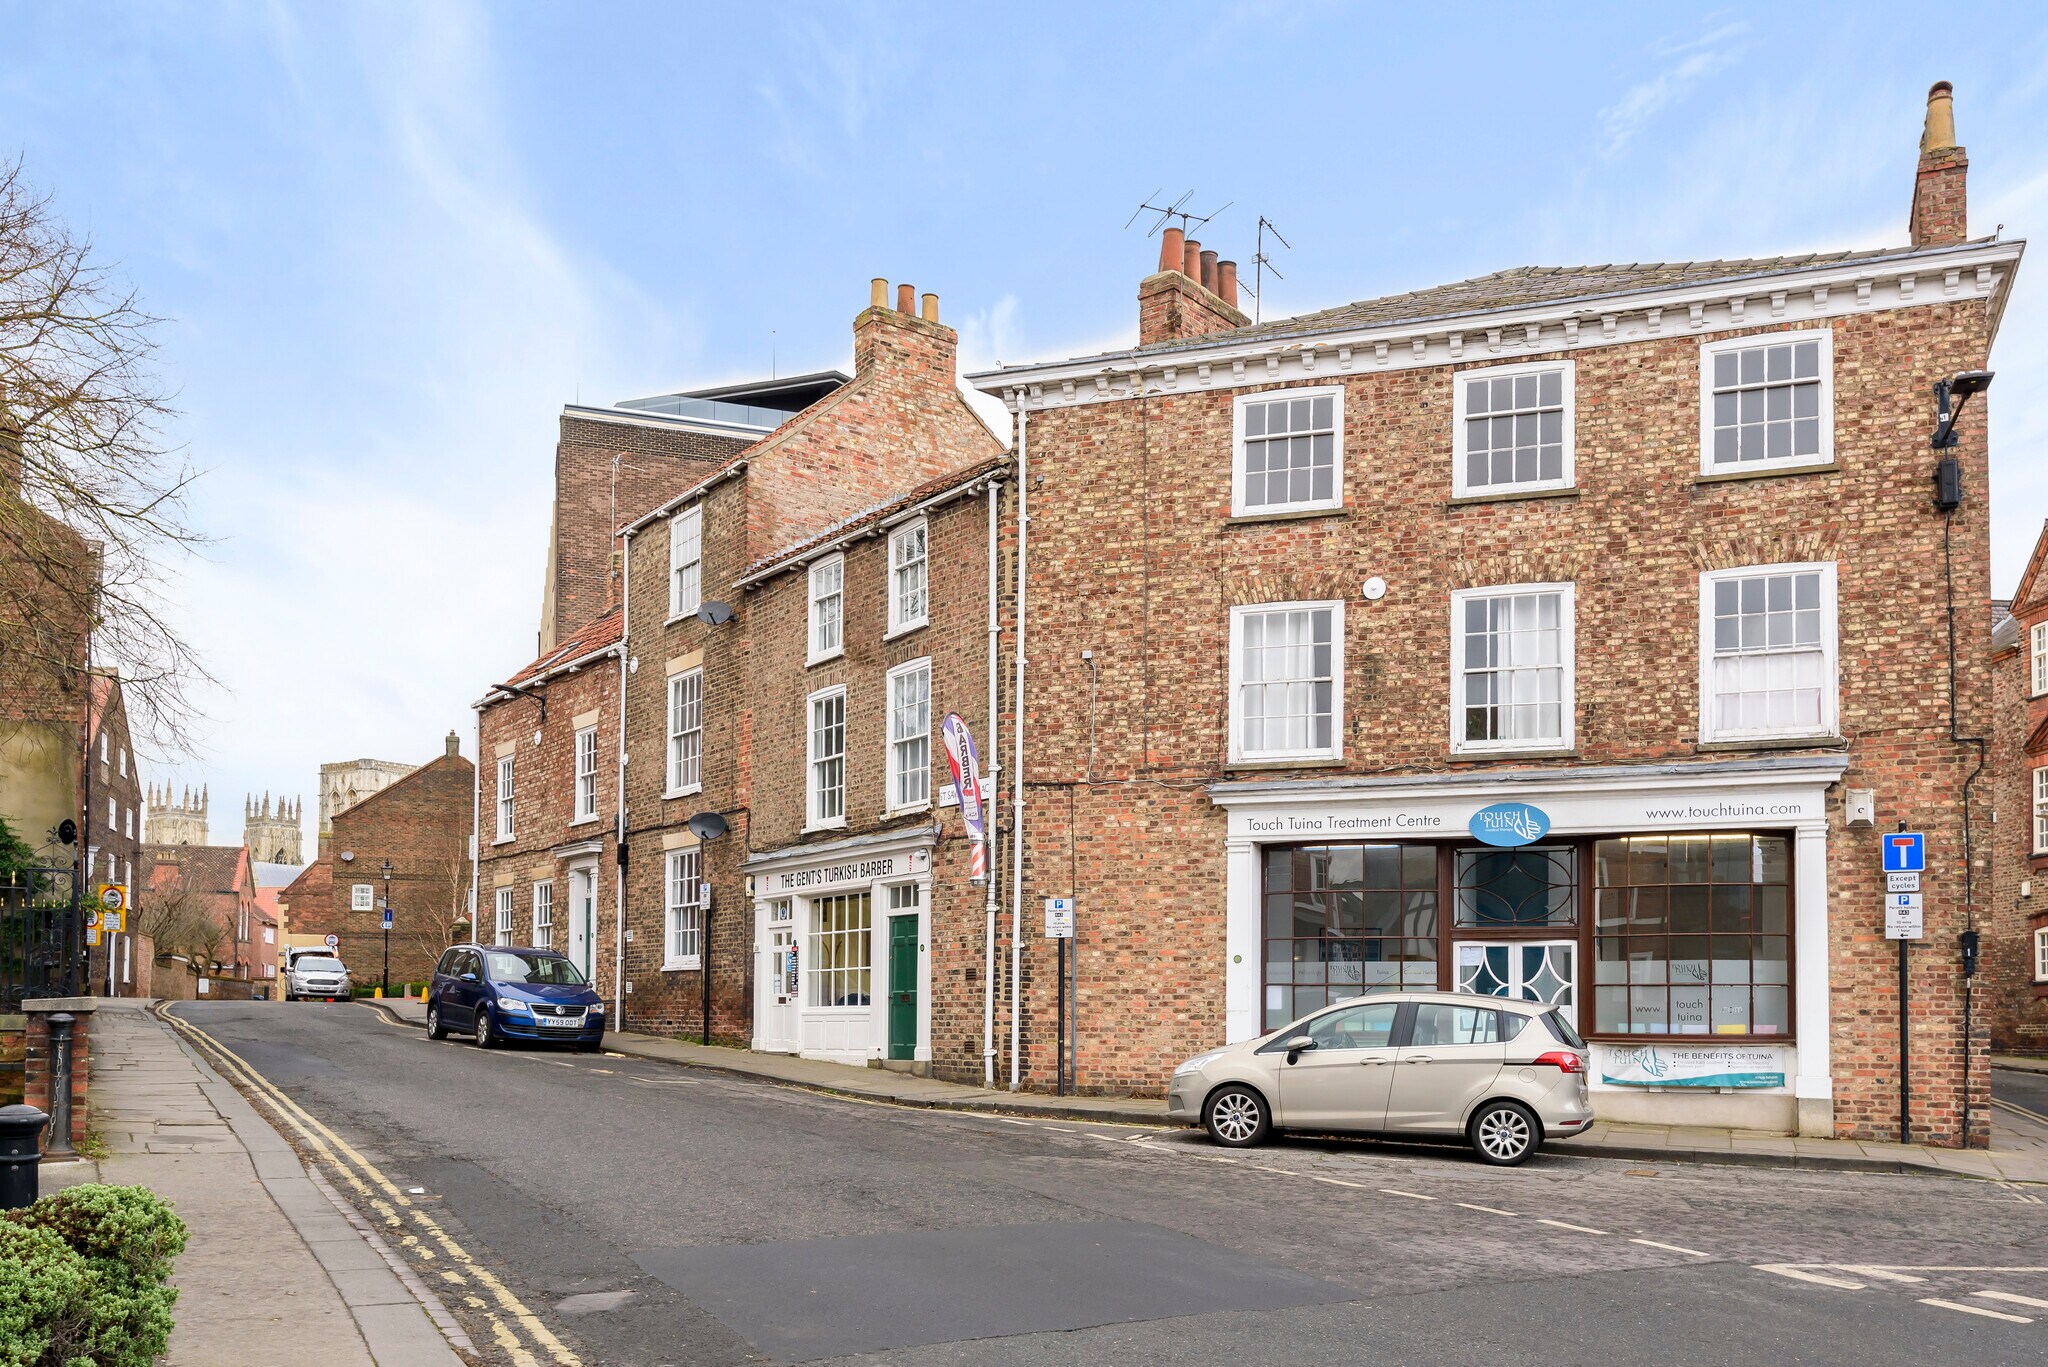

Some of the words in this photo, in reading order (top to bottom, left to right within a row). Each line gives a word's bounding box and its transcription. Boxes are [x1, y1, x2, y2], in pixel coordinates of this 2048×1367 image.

[1646, 802, 1801, 819] www.touchtuina.com
[1478, 811, 1520, 821] TOUCH
[1247, 817, 1283, 831] Touch
[1288, 816, 1322, 830] Tuina
[1327, 815, 1391, 829] Treatment
[1395, 813, 1441, 827] Centre
[1484, 819, 1523, 829] TUINA
[781, 873, 794, 889] THE
[796, 869, 822, 887] GENT'S
[824, 864, 858, 883] TURKISH
[860, 859, 893, 878] BARBER
[1056, 900, 1063, 908] P
[1900, 895, 1909, 905] P
[1675, 999, 1703, 1009] touch
[1677, 1012, 1703, 1022] tuina
[1608, 1049, 1647, 1058] TOUCH
[1672, 1052, 1690, 1060] THE
[1692, 1052, 1734, 1060] BENEFITS
